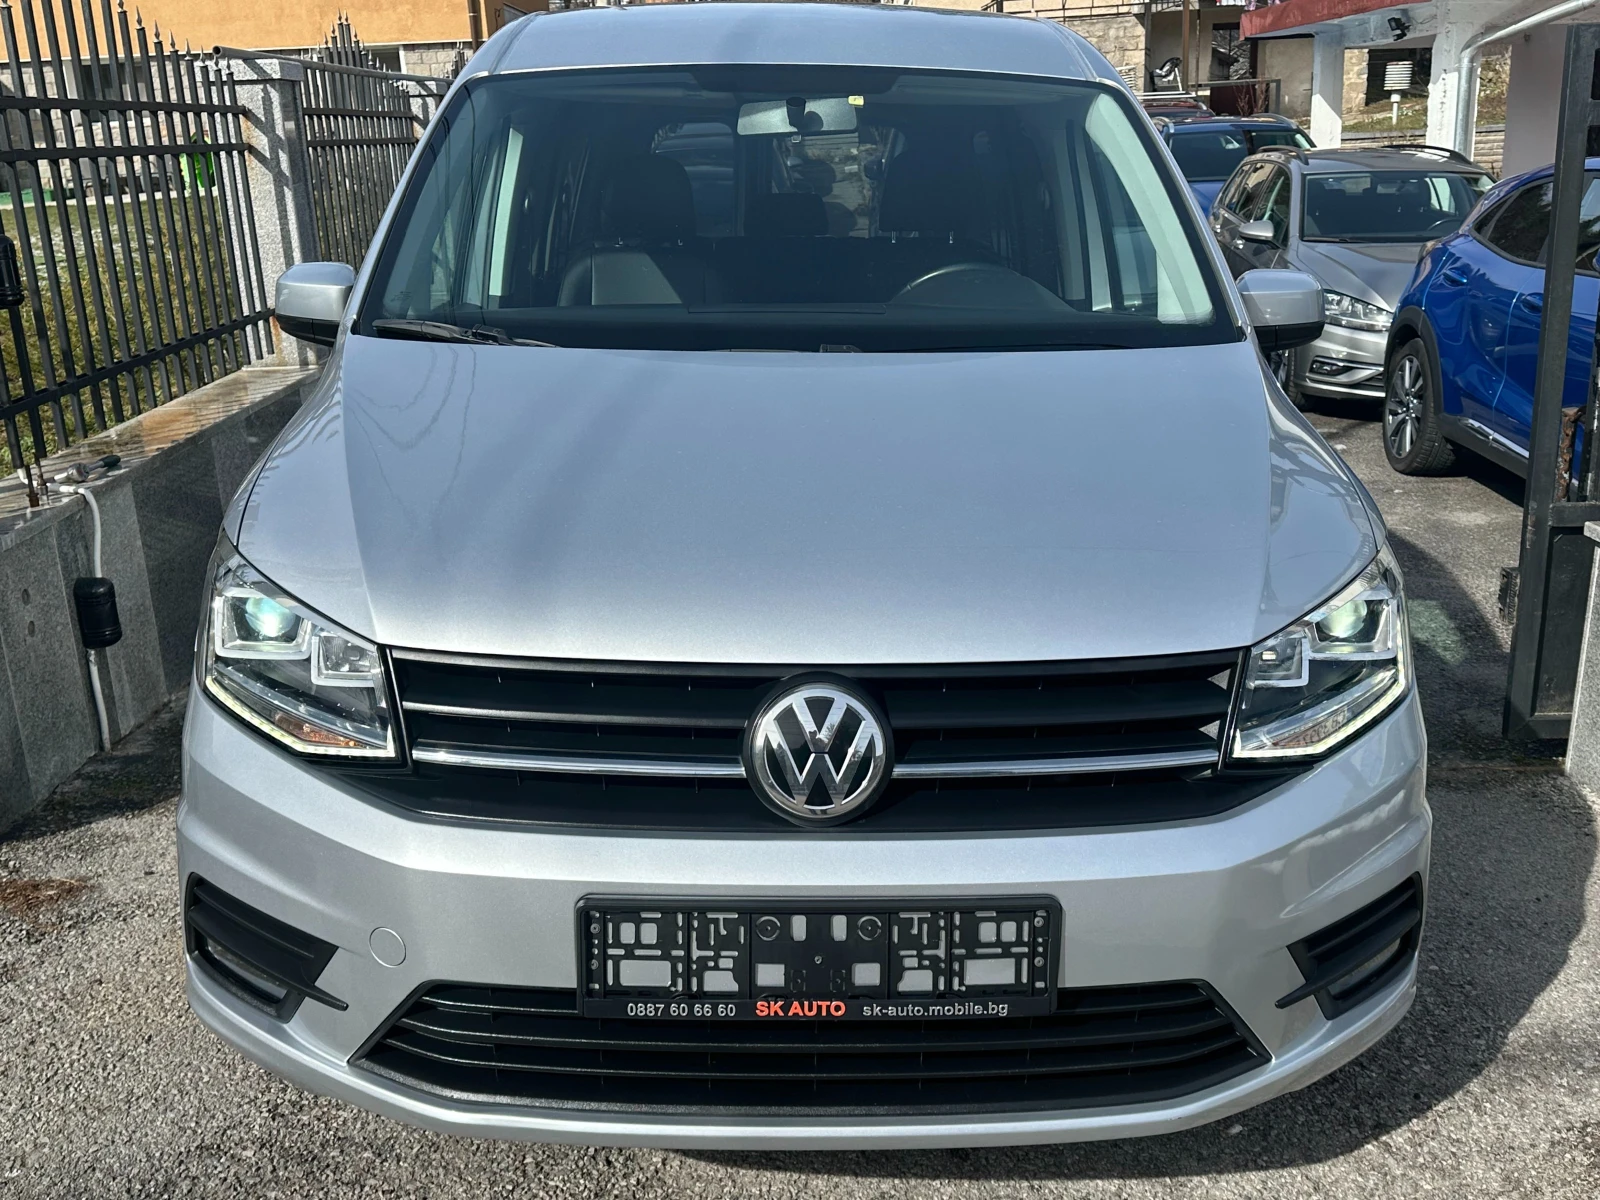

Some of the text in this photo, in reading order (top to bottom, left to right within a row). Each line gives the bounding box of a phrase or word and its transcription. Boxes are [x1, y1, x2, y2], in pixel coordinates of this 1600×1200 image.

[755, 687, 884, 815] VW
[627, 1003, 737, 1017] 0887 60 66 60
[755, 1001, 846, 1017] SK AUTO
[862, 1002, 1009, 1017] sk-auto.mobile.bg
